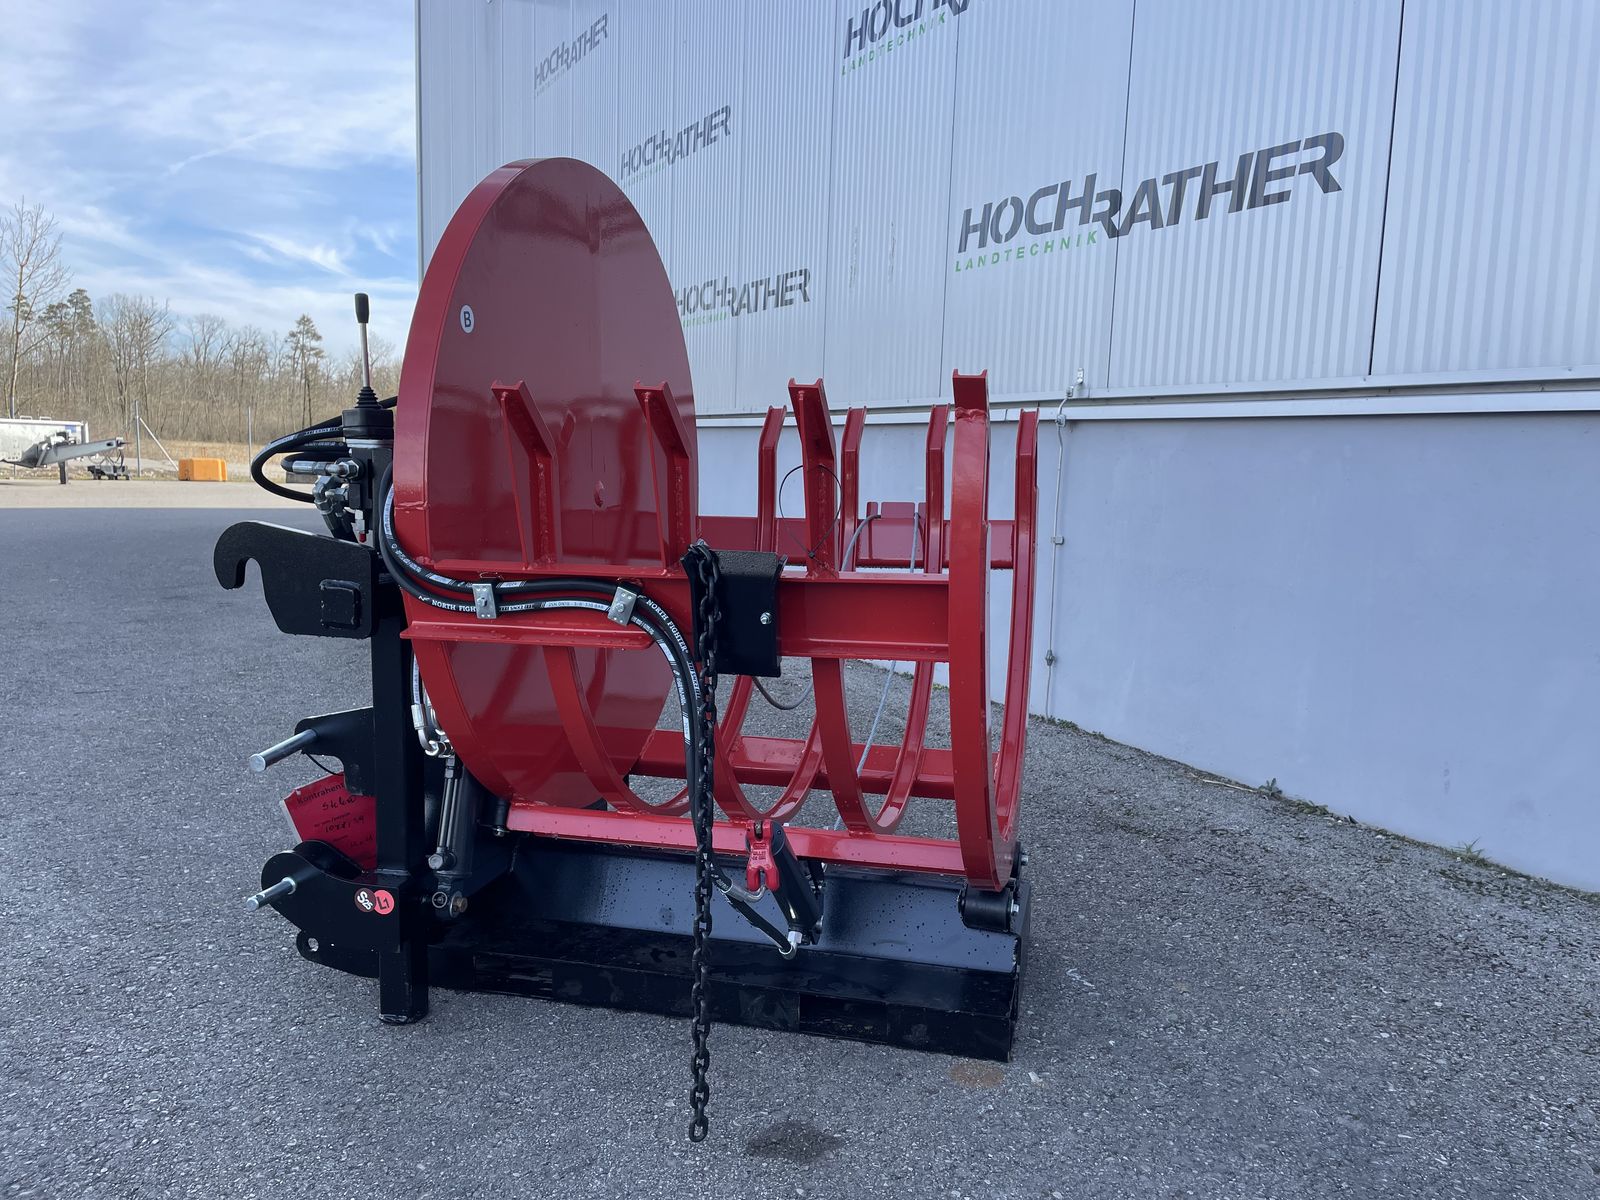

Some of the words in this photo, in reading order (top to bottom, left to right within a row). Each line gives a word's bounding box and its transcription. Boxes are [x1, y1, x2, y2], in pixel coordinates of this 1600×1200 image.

[841, 12, 946, 77] LANDTECHNIK
[620, 105, 731, 181] HOCHRATHER
[957, 131, 1345, 254] HOCHRATHER
[954, 230, 1098, 273] LANDTECHNIK
[463, 310, 472, 328] B
[431, 599, 456, 611] NORTH
[646, 599, 670, 621] NORTH
[377, 896, 390, 910] L1
